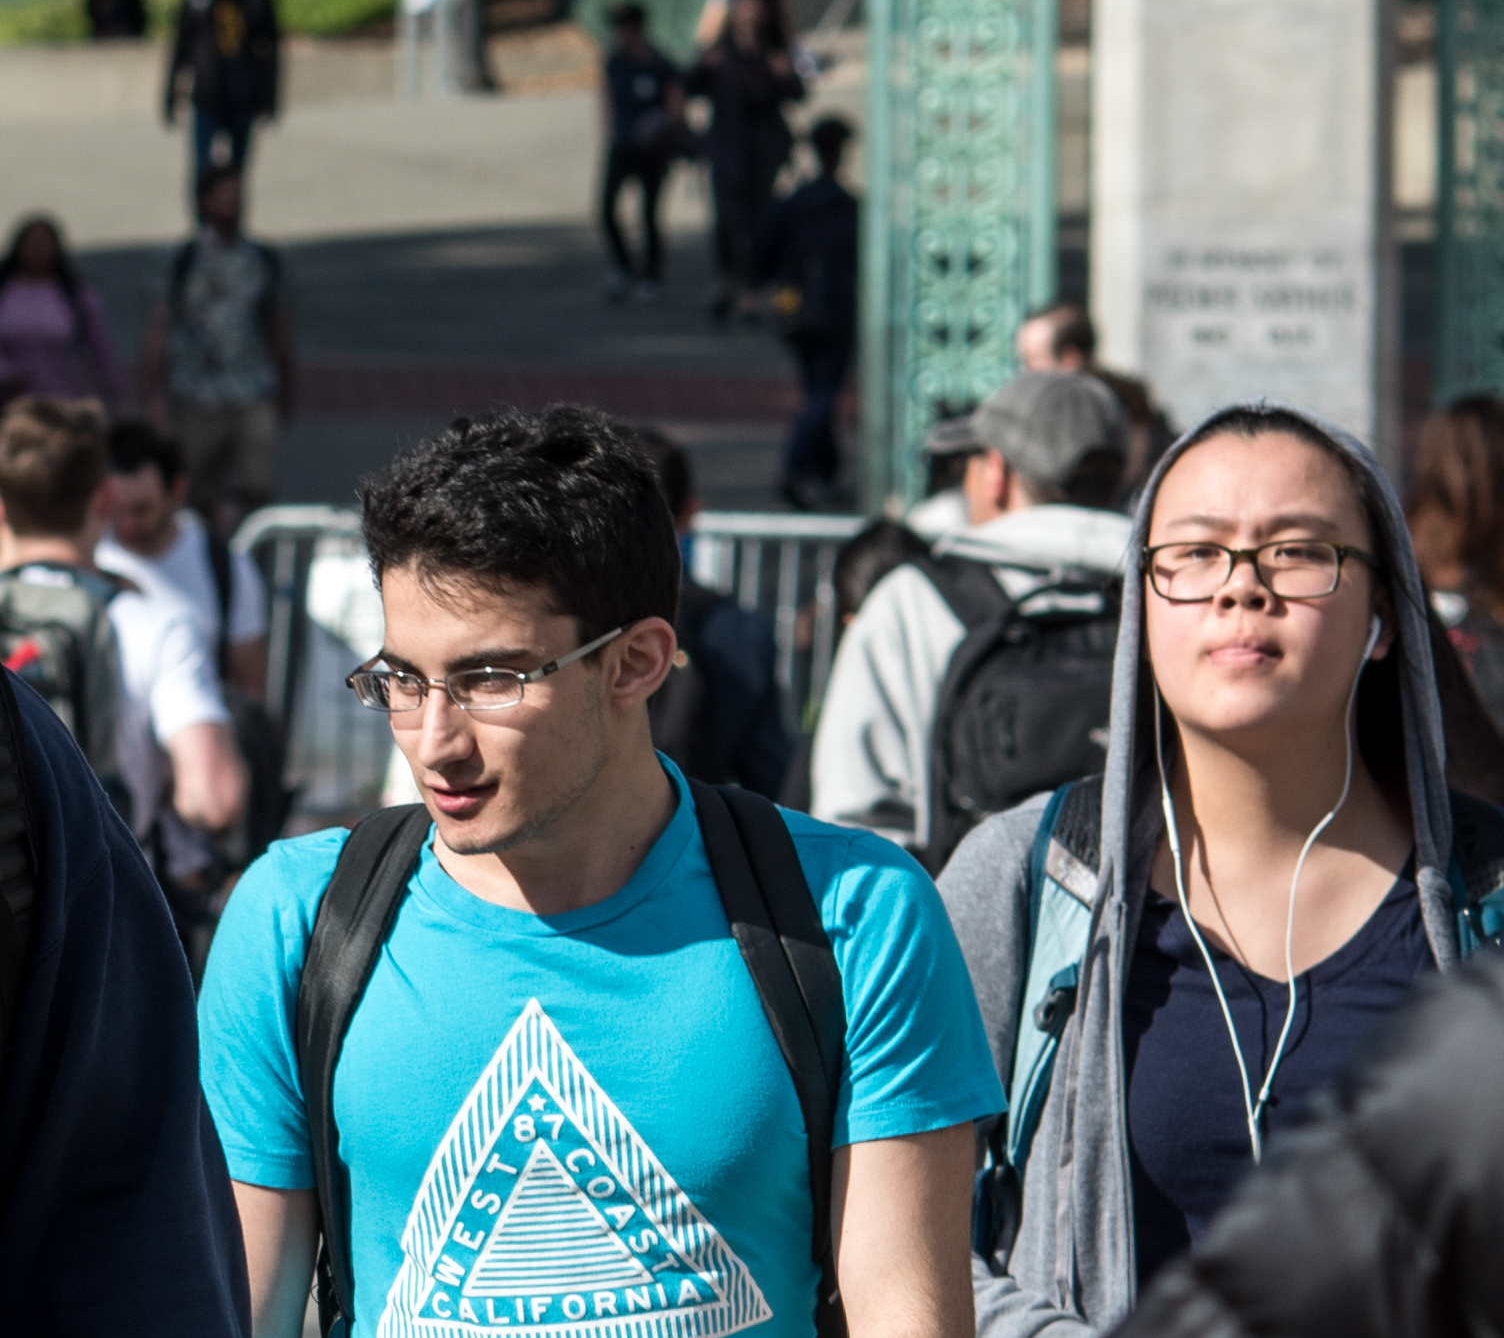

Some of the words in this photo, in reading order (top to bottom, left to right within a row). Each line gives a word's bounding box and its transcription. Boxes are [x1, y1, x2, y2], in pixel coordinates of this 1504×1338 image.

[512, 1113, 565, 1144] 87
[435, 1151, 520, 1288] WEST
[565, 1147, 680, 1272] COAST
[431, 1277, 702, 1325] CALIFORNIA
